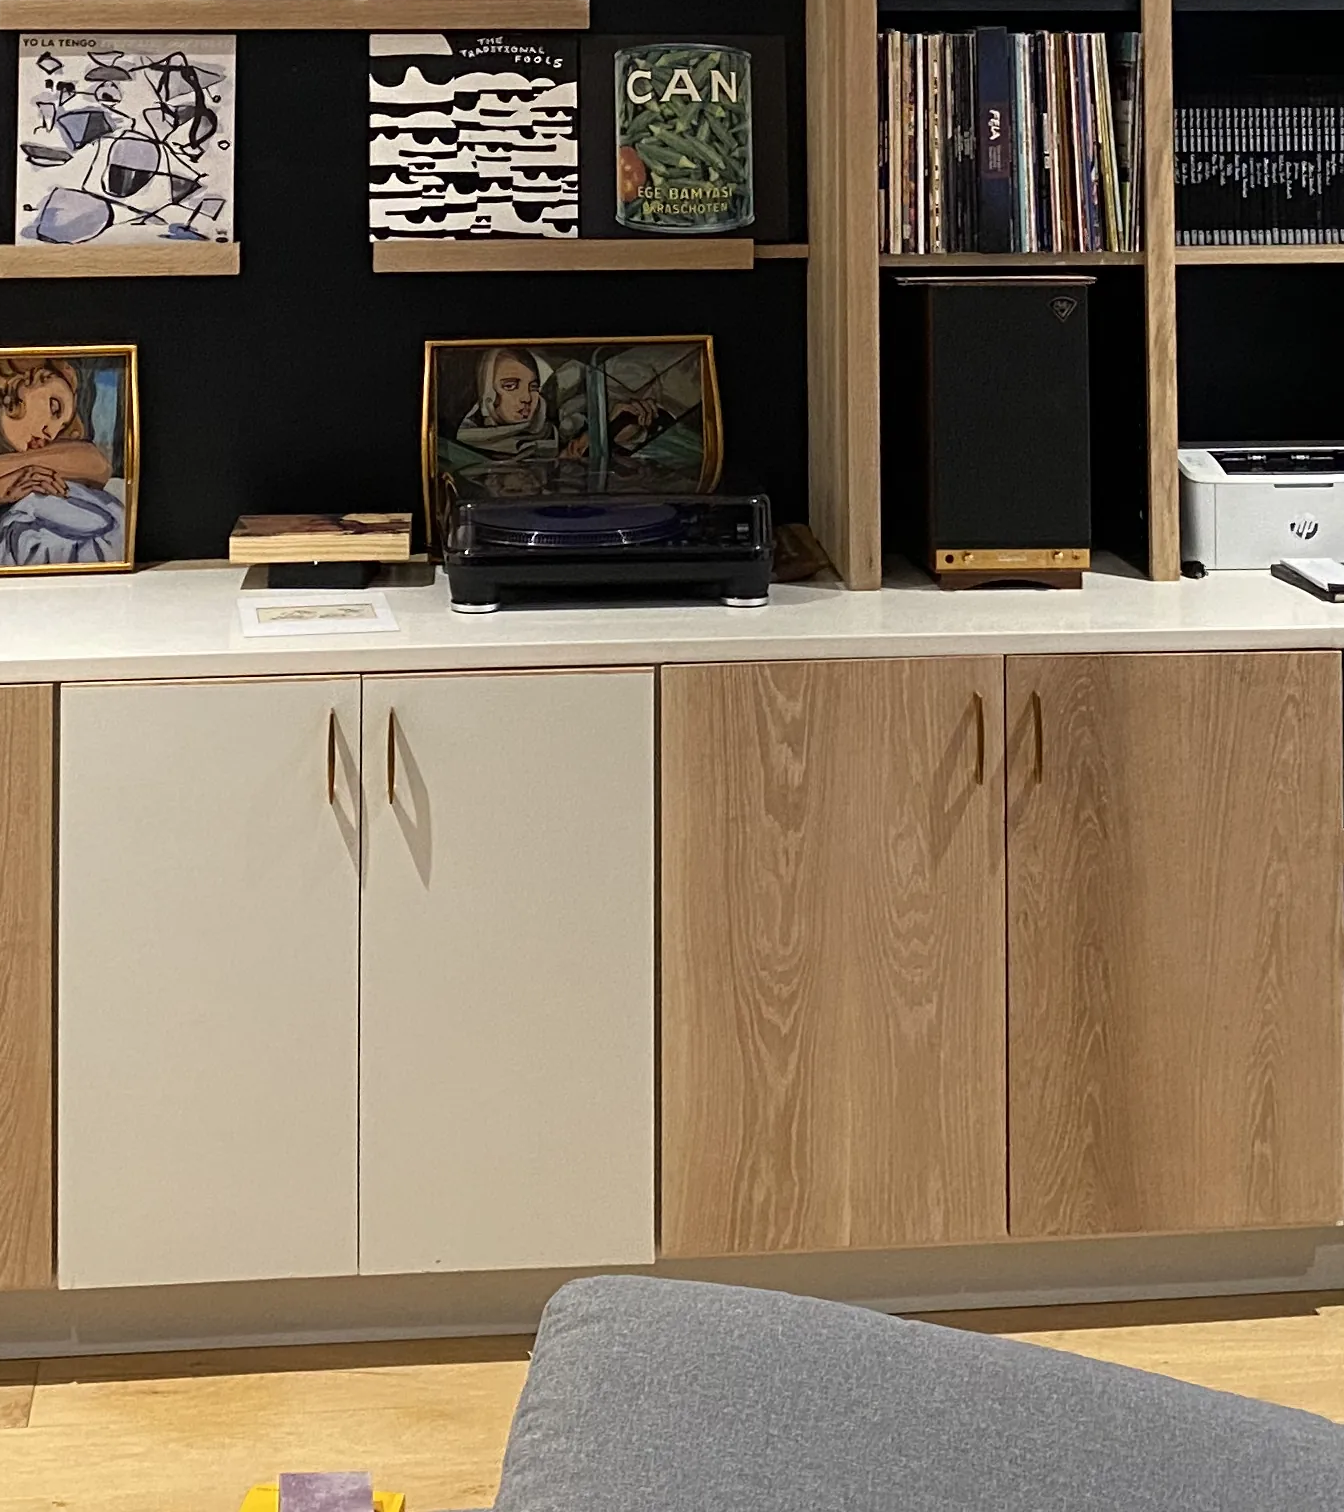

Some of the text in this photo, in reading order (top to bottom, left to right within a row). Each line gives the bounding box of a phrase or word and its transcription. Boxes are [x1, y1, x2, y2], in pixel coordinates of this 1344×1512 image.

[23, 39, 96, 47] YO LA TENGO
[477, 36, 503, 45] THE
[459, 45, 545, 58] TRADITIONAL
[515, 55, 563, 68] FOOLS
[626, 68, 737, 104] CAN
[637, 186, 733, 200] EGE BAMYASI
